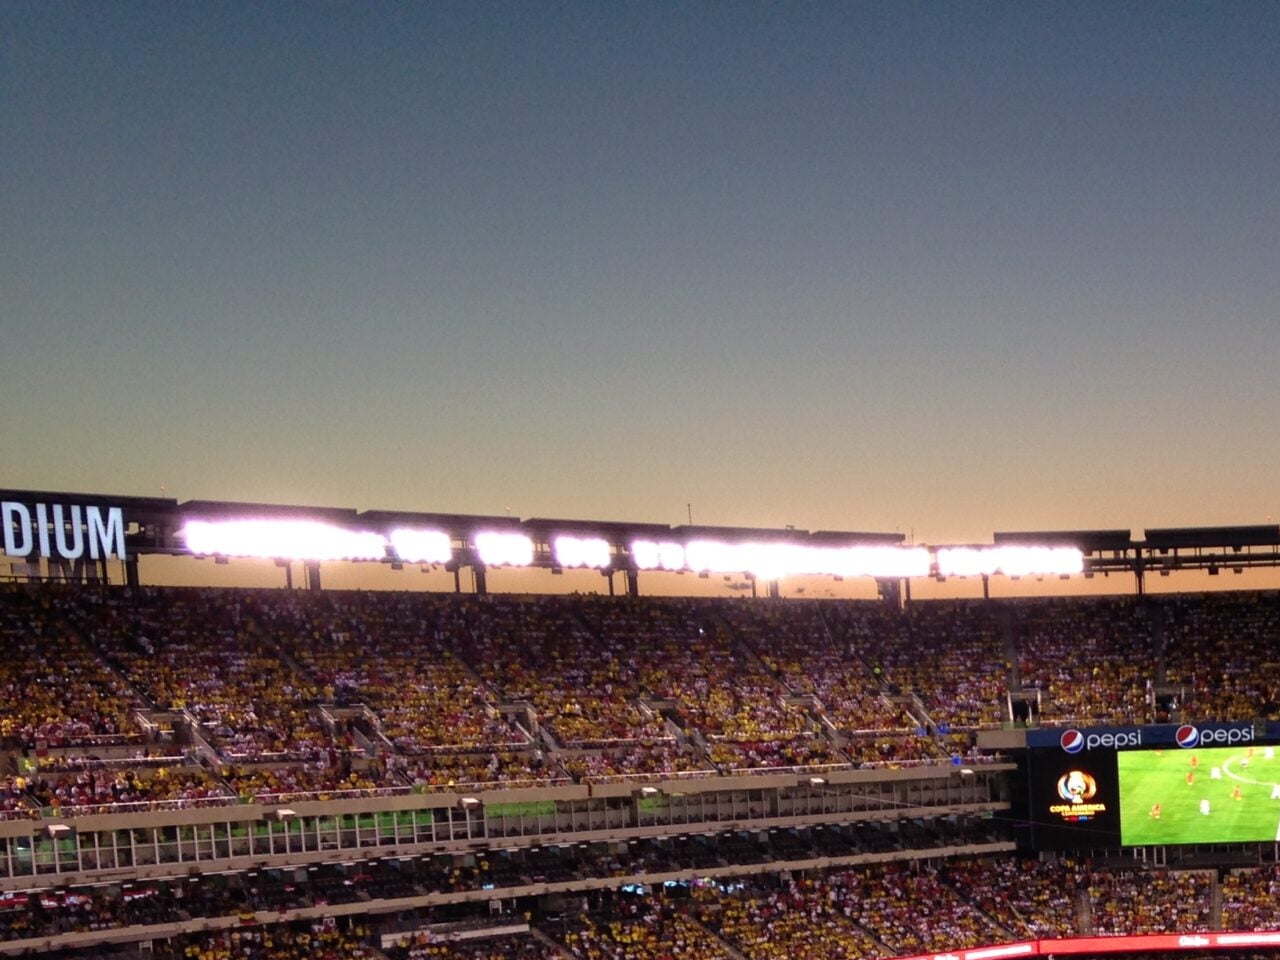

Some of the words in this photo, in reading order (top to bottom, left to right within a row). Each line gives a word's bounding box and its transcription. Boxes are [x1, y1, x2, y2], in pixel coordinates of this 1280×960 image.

[1, 501, 126, 560] DIUM
[1087, 729, 1141, 749] pepsi
[1200, 725, 1255, 744] pepsi
